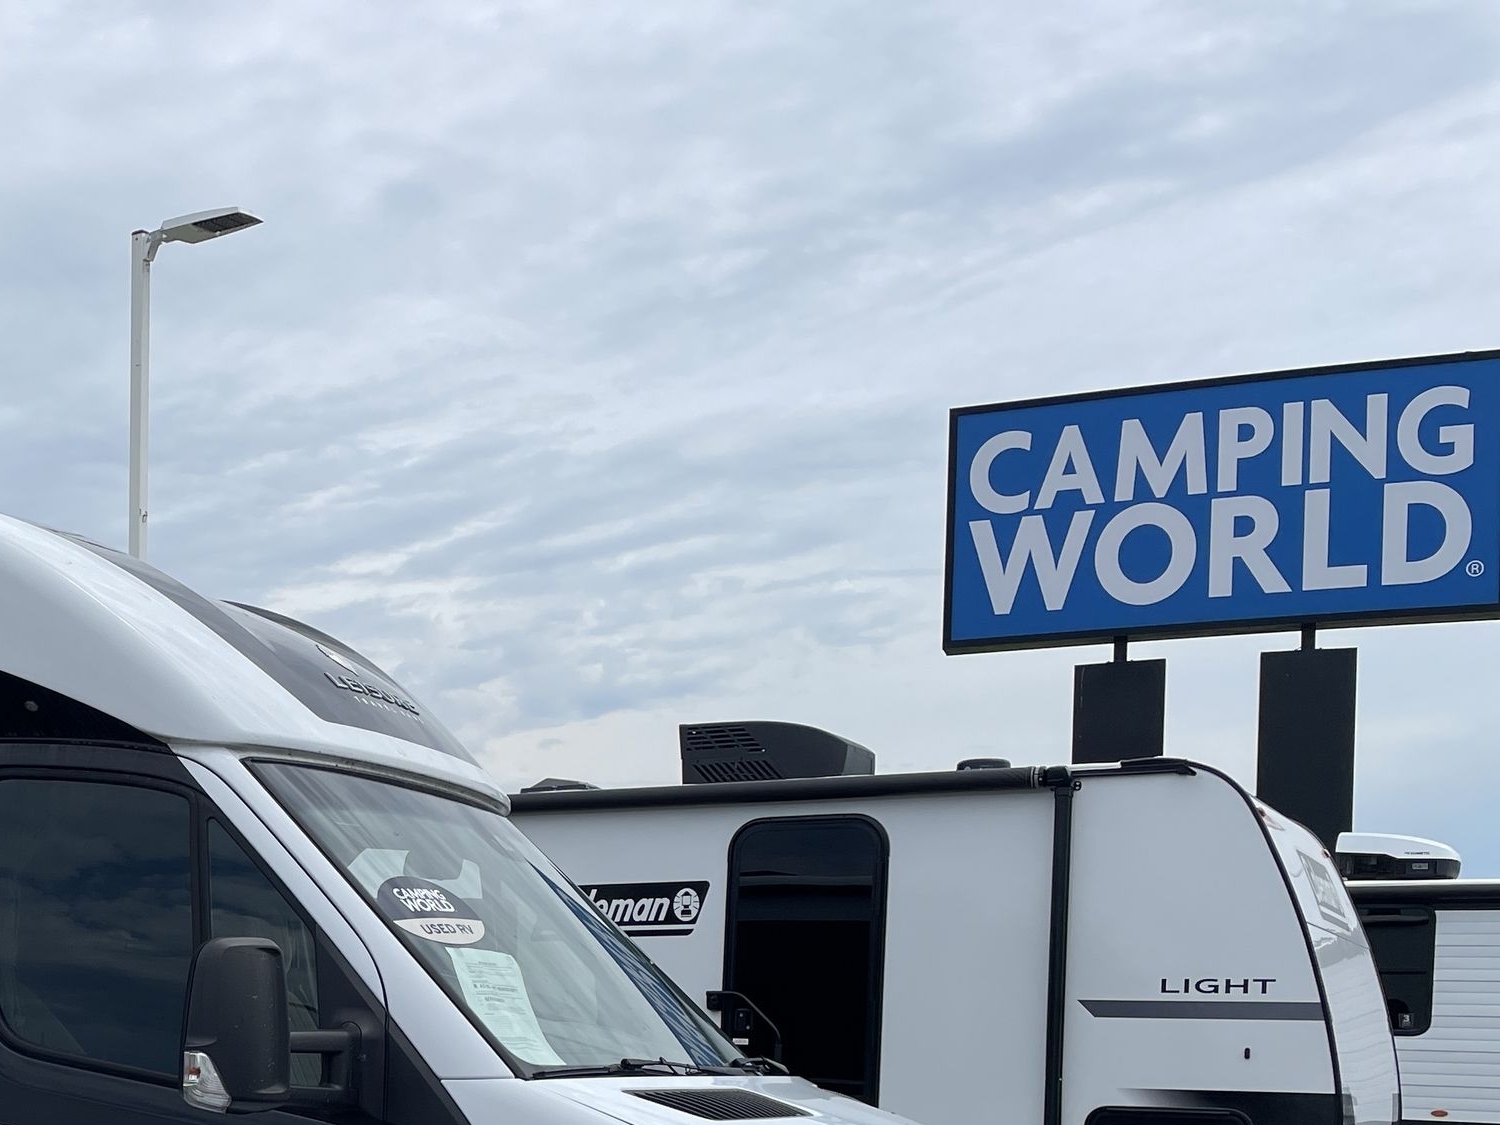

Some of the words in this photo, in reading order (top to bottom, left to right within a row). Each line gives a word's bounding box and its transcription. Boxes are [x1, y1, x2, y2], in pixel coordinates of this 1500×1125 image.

[969, 385, 1475, 515] CAMPING
[969, 480, 1474, 616] WORLD
[323, 671, 420, 716] LEISURE
[393, 888, 446, 901] CAMPING
[400, 898, 454, 911] WORLD
[420, 924, 457, 934] USED
[456, 925, 474, 934] RV
[1160, 978, 1277, 994] LIGHT
